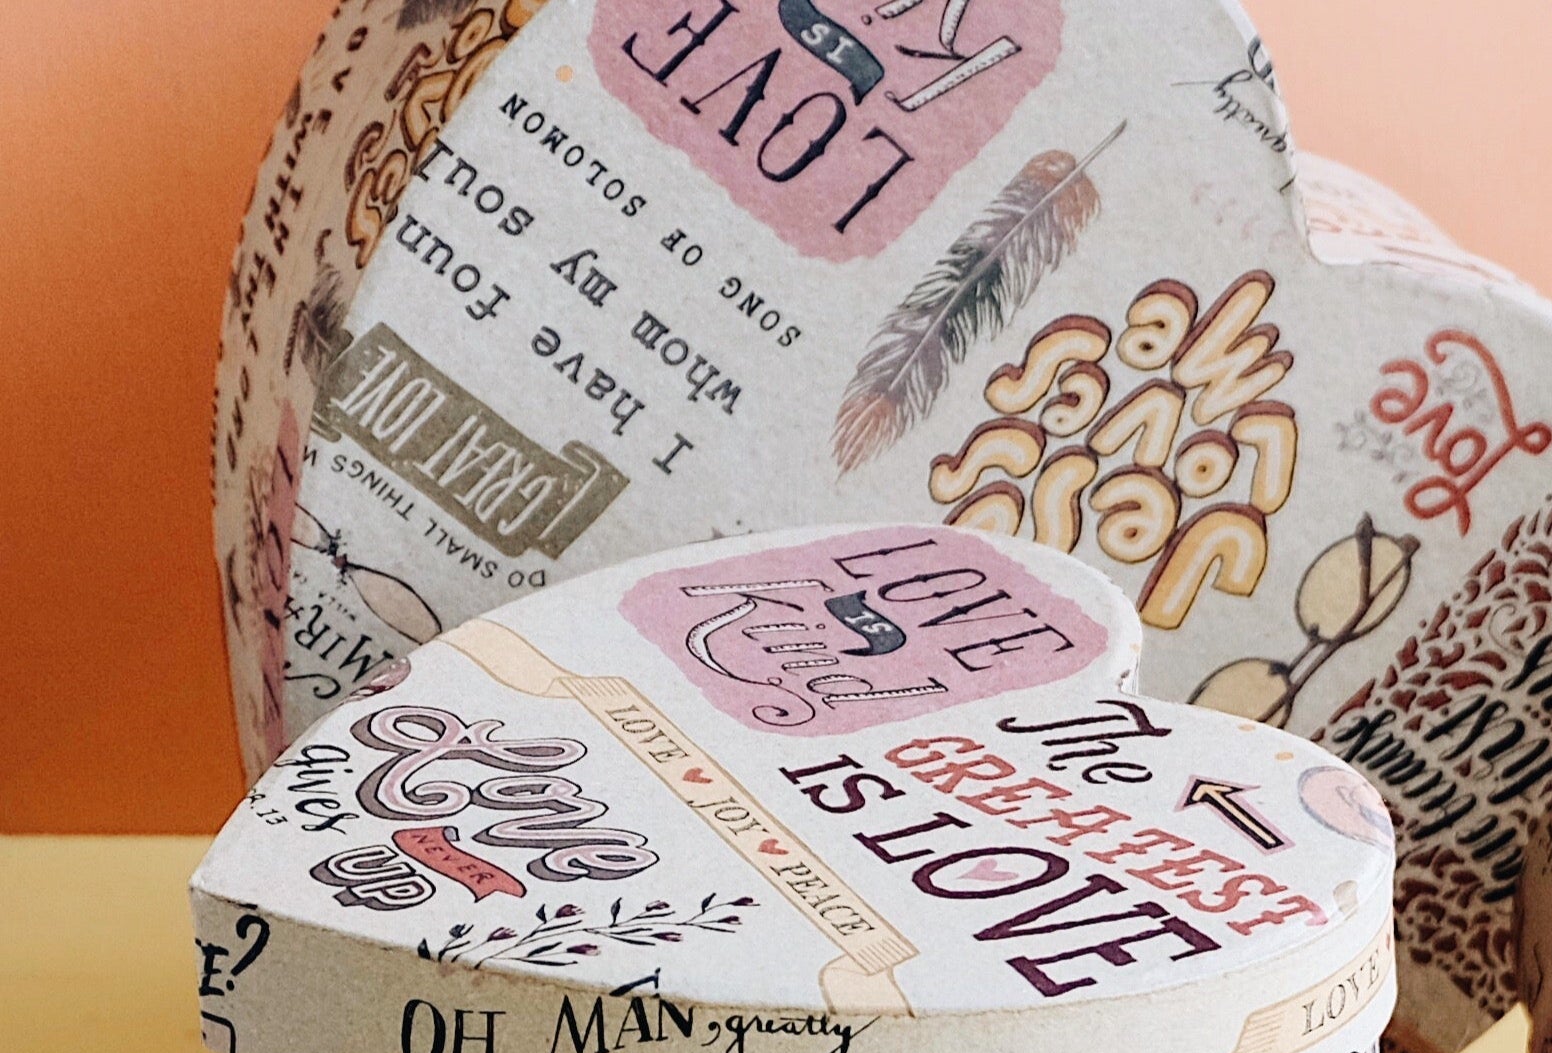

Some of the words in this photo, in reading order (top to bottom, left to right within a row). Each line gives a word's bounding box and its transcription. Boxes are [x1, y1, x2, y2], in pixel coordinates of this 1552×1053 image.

[800, 22, 855, 65] IS
[500, 92, 646, 218] SOLOMON
[620, 0, 915, 235] LOVE
[412, 138, 535, 236] soul
[392, 213, 511, 322] foun
[550, 248, 618, 307] my
[661, 228, 703, 267] OF
[717, 276, 801, 347] SONG
[341, 344, 446, 455] LOVE
[531, 326, 645, 437] have
[630, 309, 742, 415] whom
[331, 454, 417, 523] THINGS
[413, 414, 548, 538] GREAT
[652, 432, 695, 475] I
[424, 519, 501, 581] SMALL
[508, 569, 547, 589] DO
[680, 577, 949, 727] Kind
[832, 538, 1075, 672] LOVE
[843, 609, 893, 636] IS
[273, 743, 361, 837] gives
[995, 699, 1174, 785] The
[350, 704, 661, 882] Love
[604, 702, 690, 764] LOVE
[686, 794, 770, 839] JOY
[771, 861, 878, 938] PEACE
[882, 735, 1331, 937] GREATEST
[309, 845, 437, 913] UP
[410, 831, 498, 888] NEVER
[778, 753, 907, 816] IS
[852, 812, 1223, 999] LOVE
[1301, 960, 1384, 1039] LOVE
